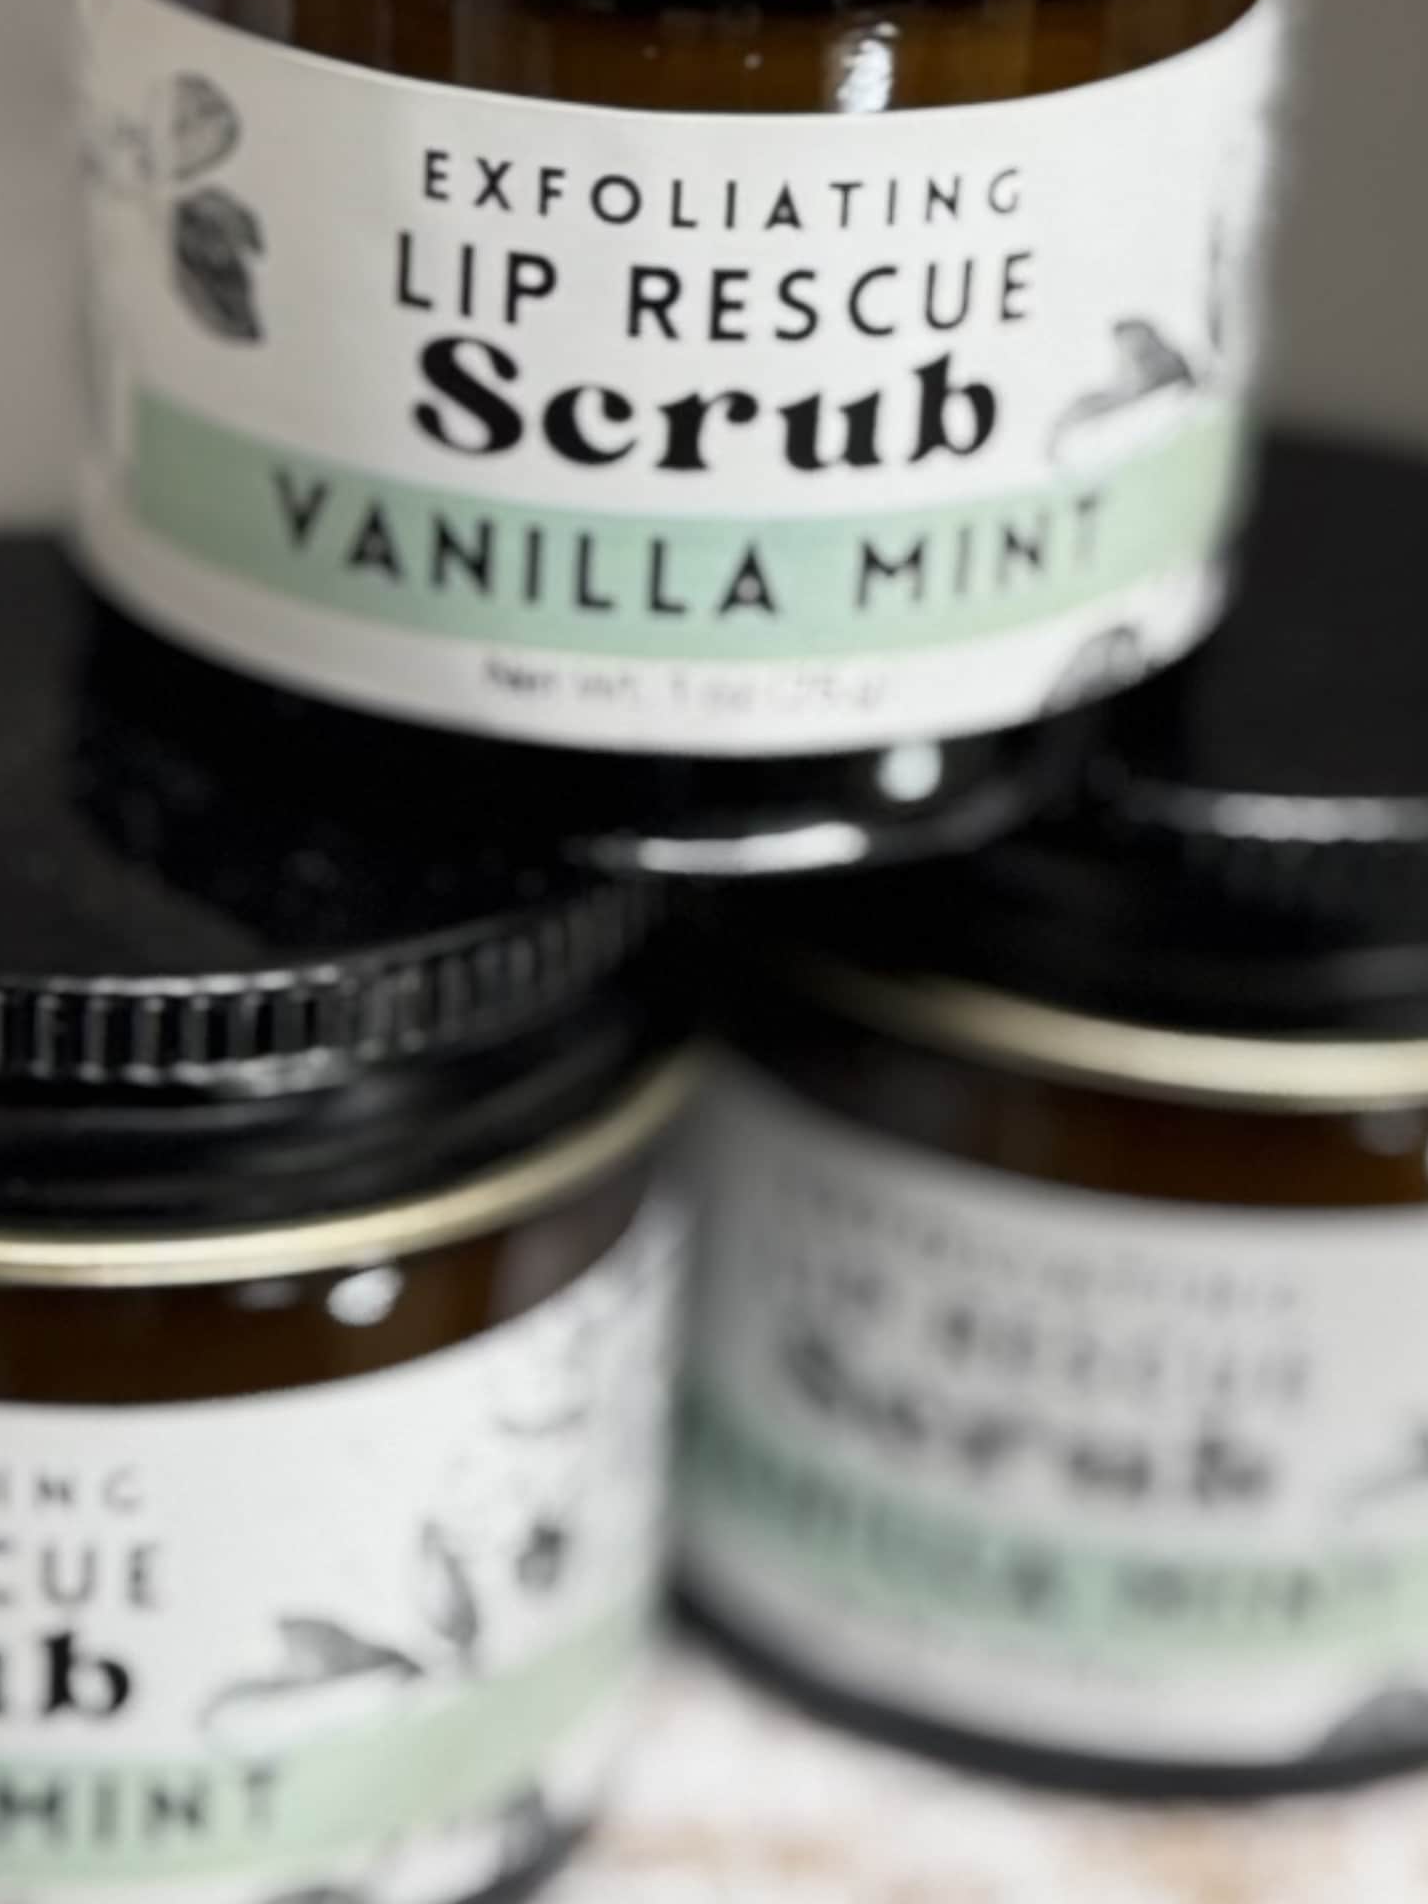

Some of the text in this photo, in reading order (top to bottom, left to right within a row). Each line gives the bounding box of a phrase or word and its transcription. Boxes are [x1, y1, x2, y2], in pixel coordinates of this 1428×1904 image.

[423, 148, 1022, 231] EXFOLIATING
[396, 230, 1034, 343] LIP RESCUE
[414, 335, 1000, 472] Scrub
[275, 470, 1102, 618] VANILLA MINT
